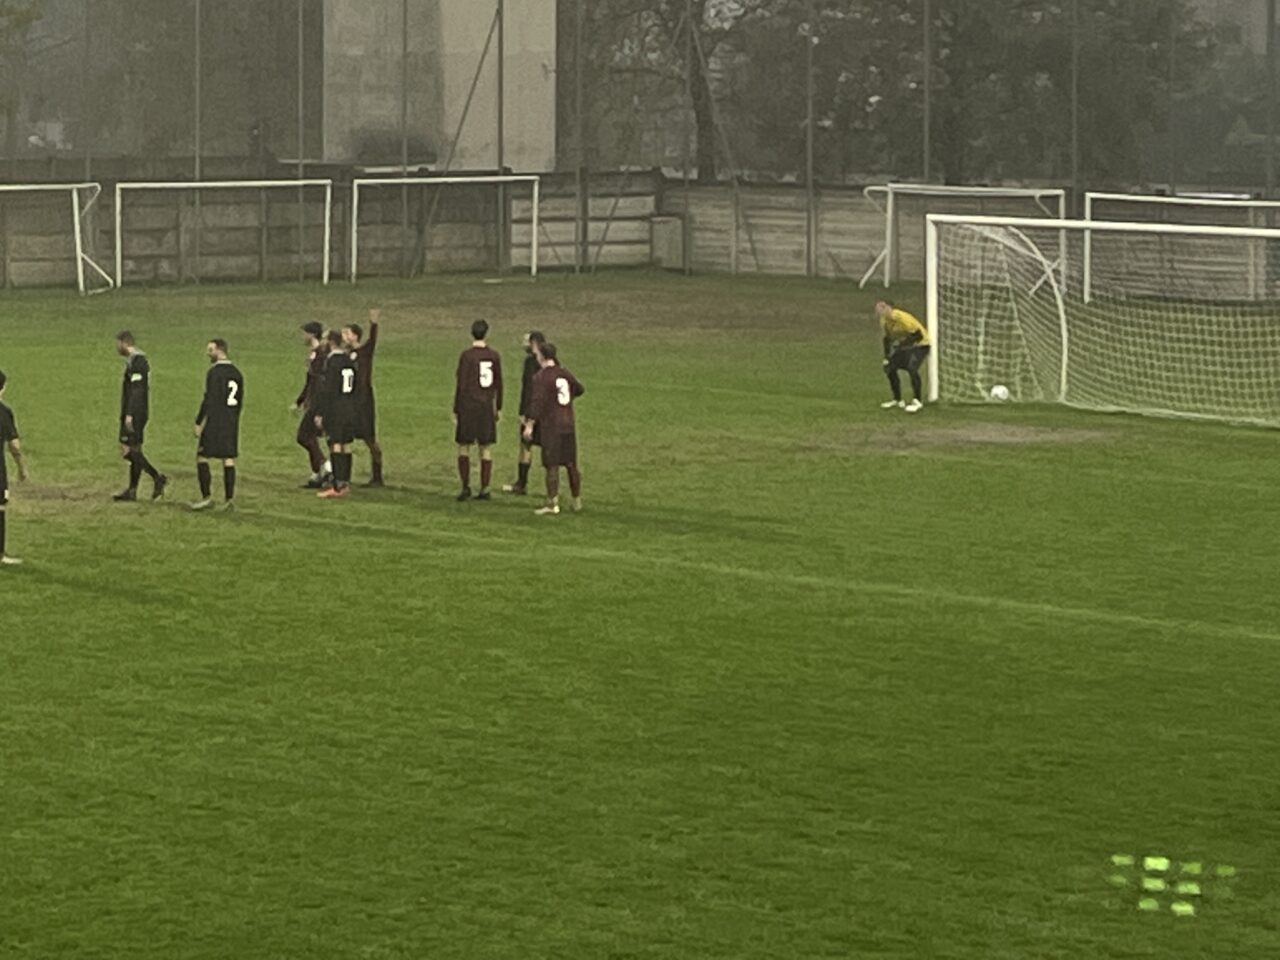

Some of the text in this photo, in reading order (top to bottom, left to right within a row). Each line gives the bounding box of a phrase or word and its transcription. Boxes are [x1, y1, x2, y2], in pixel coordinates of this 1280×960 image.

[479, 361, 494, 388] 5
[226, 380, 239, 406] 2
[555, 378, 570, 406] 3
